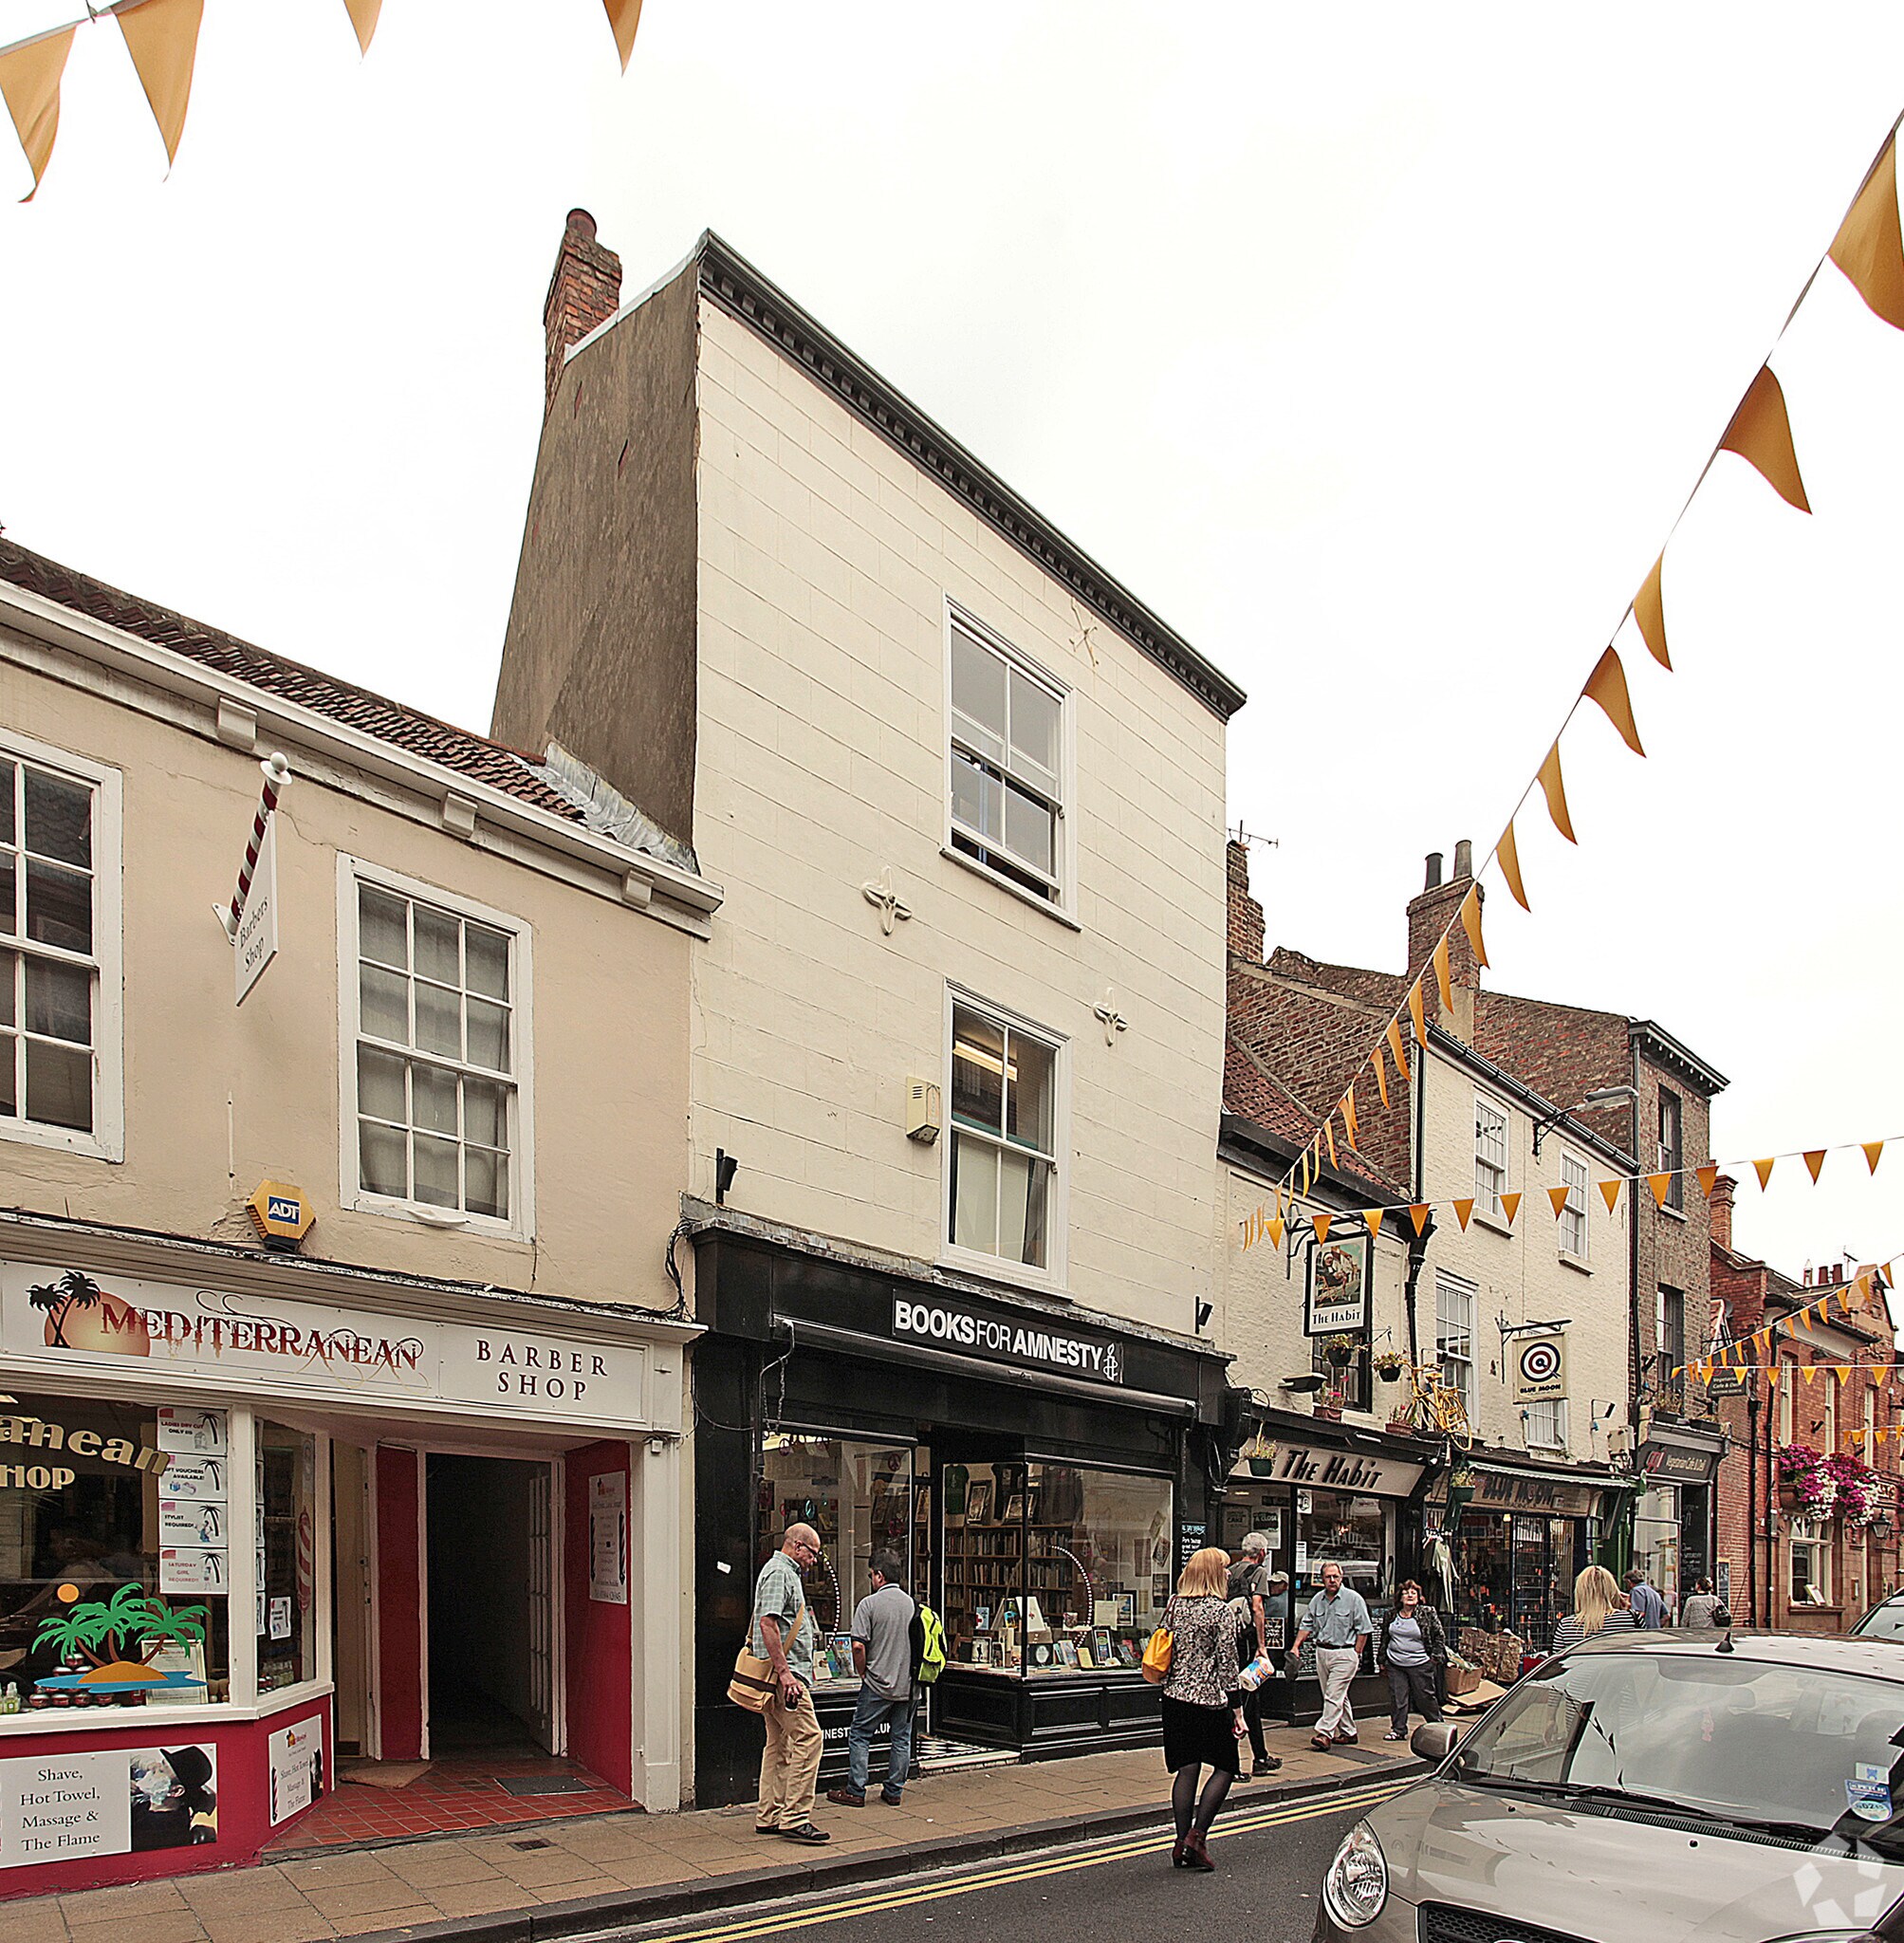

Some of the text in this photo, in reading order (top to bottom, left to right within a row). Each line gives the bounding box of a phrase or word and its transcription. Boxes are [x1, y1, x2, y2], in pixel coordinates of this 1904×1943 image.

[239, 897, 268, 949] Barbers
[245, 937, 265, 973] Shop
[268, 1201, 300, 1220] ADT
[100, 1292, 425, 1372] MEDITERRANEAN
[895, 1300, 1103, 1371] BOOKS FOR AMNESTY
[476, 1339, 608, 1377] BARBER
[497, 1372, 587, 1400] SHOP
[1538, 1383, 1562, 1392] MOON
[37, 1768, 83, 1782] Shave,
[20, 1786, 101, 1806] Hot Towel,
[22, 1809, 100, 1829] Massage &
[20, 1834, 101, 1852] The Flame
